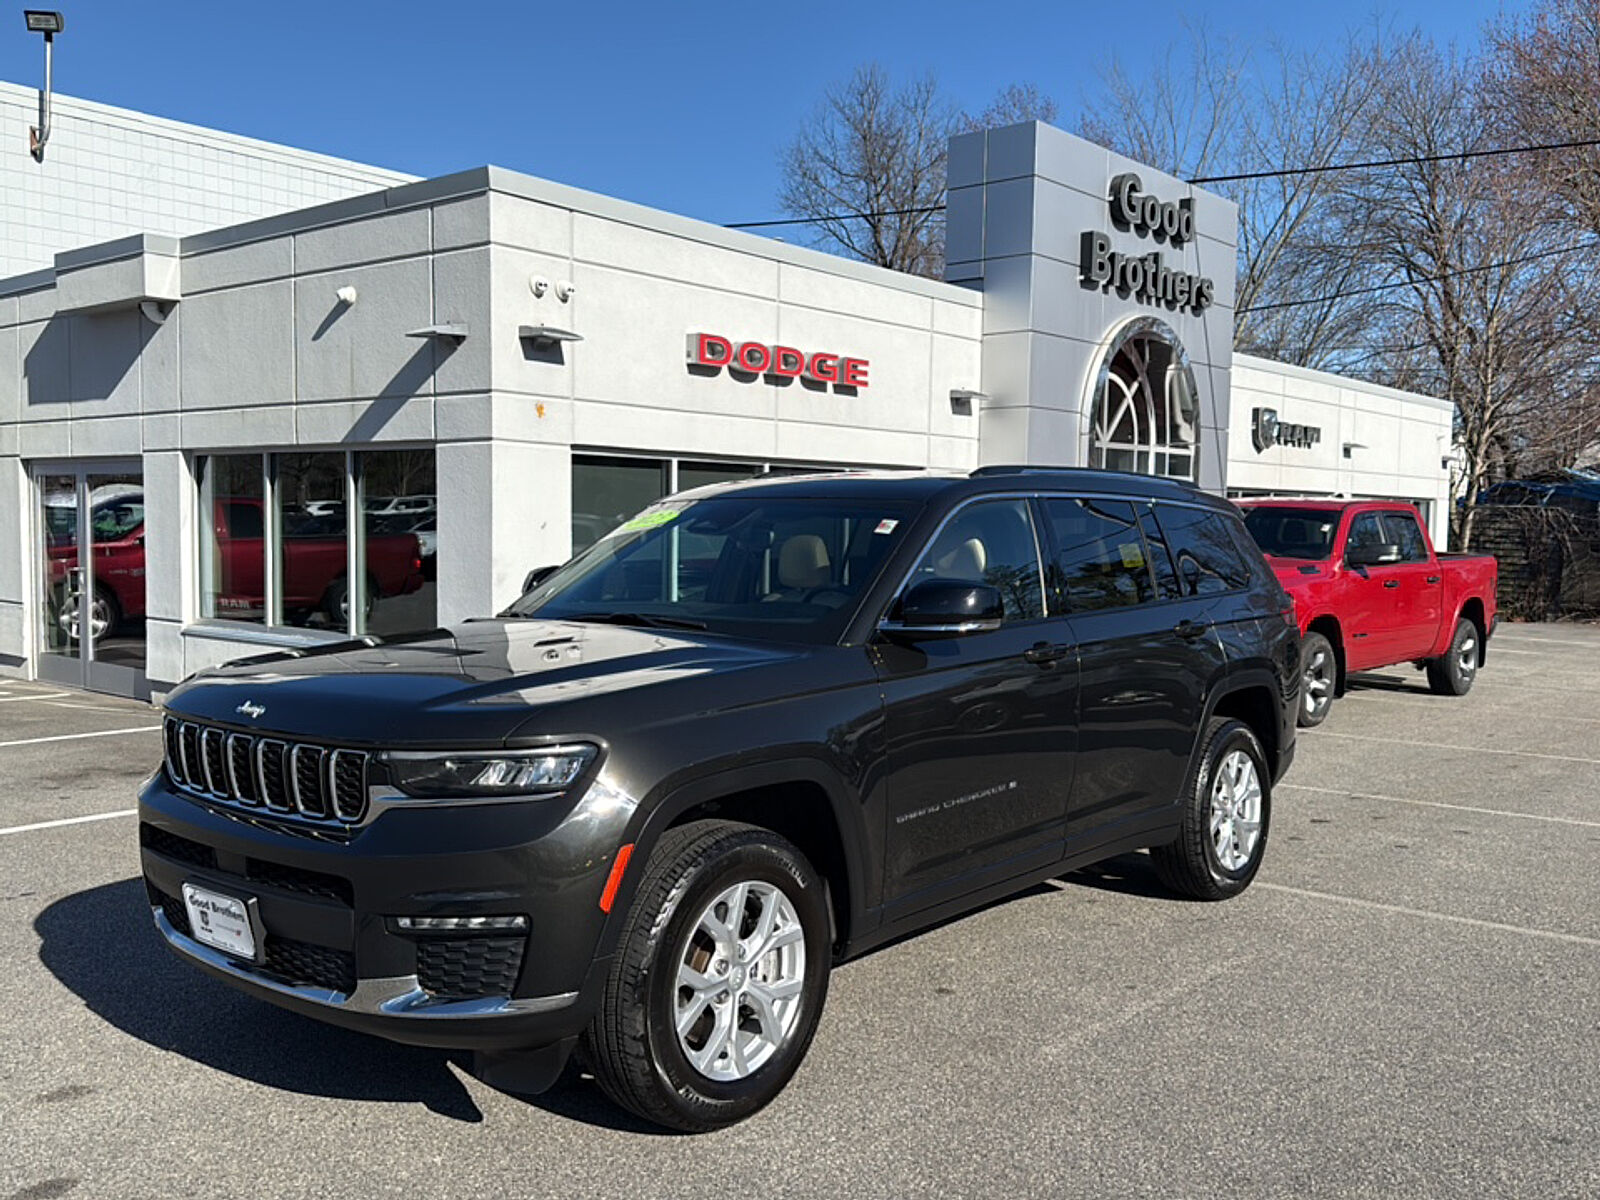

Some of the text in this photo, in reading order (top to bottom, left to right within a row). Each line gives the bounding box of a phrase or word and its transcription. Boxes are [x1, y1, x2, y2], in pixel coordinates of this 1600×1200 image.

[1110, 172, 1196, 246] Good
[1080, 231, 1214, 311] Brothers
[687, 332, 870, 390] DODGE
